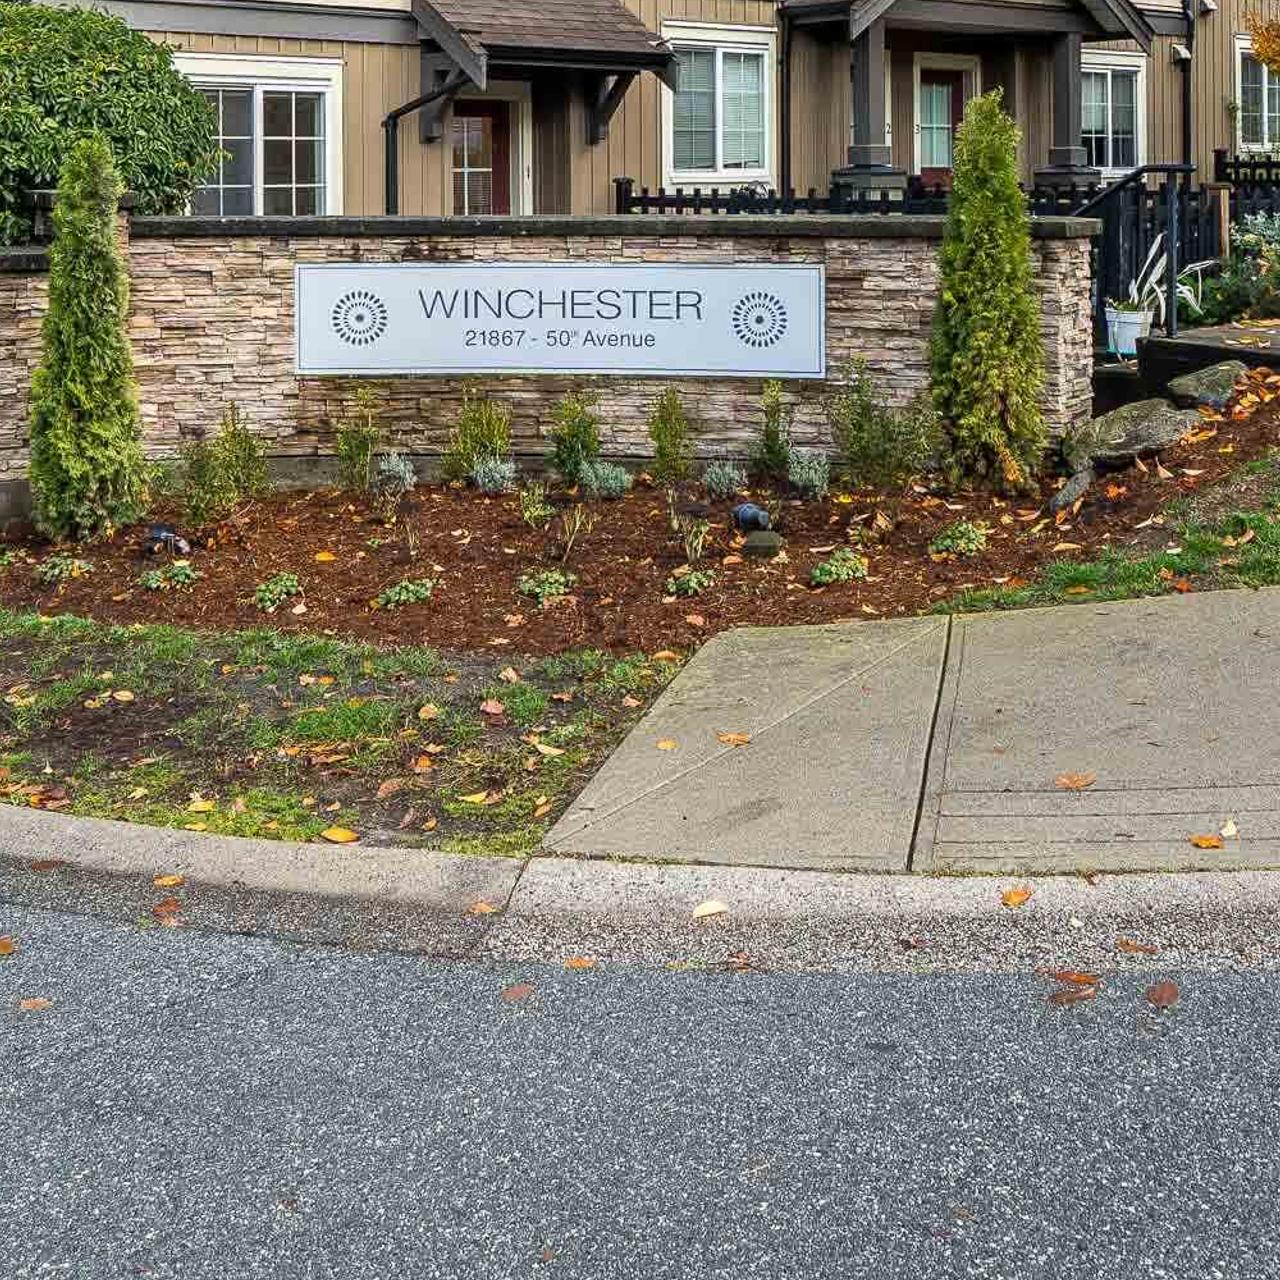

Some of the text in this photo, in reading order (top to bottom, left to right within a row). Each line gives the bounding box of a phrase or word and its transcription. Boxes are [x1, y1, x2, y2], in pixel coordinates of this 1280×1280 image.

[418, 289, 702, 320] WINCHESTER
[465, 330, 526, 347] 21867
[582, 330, 656, 347] Avenue
